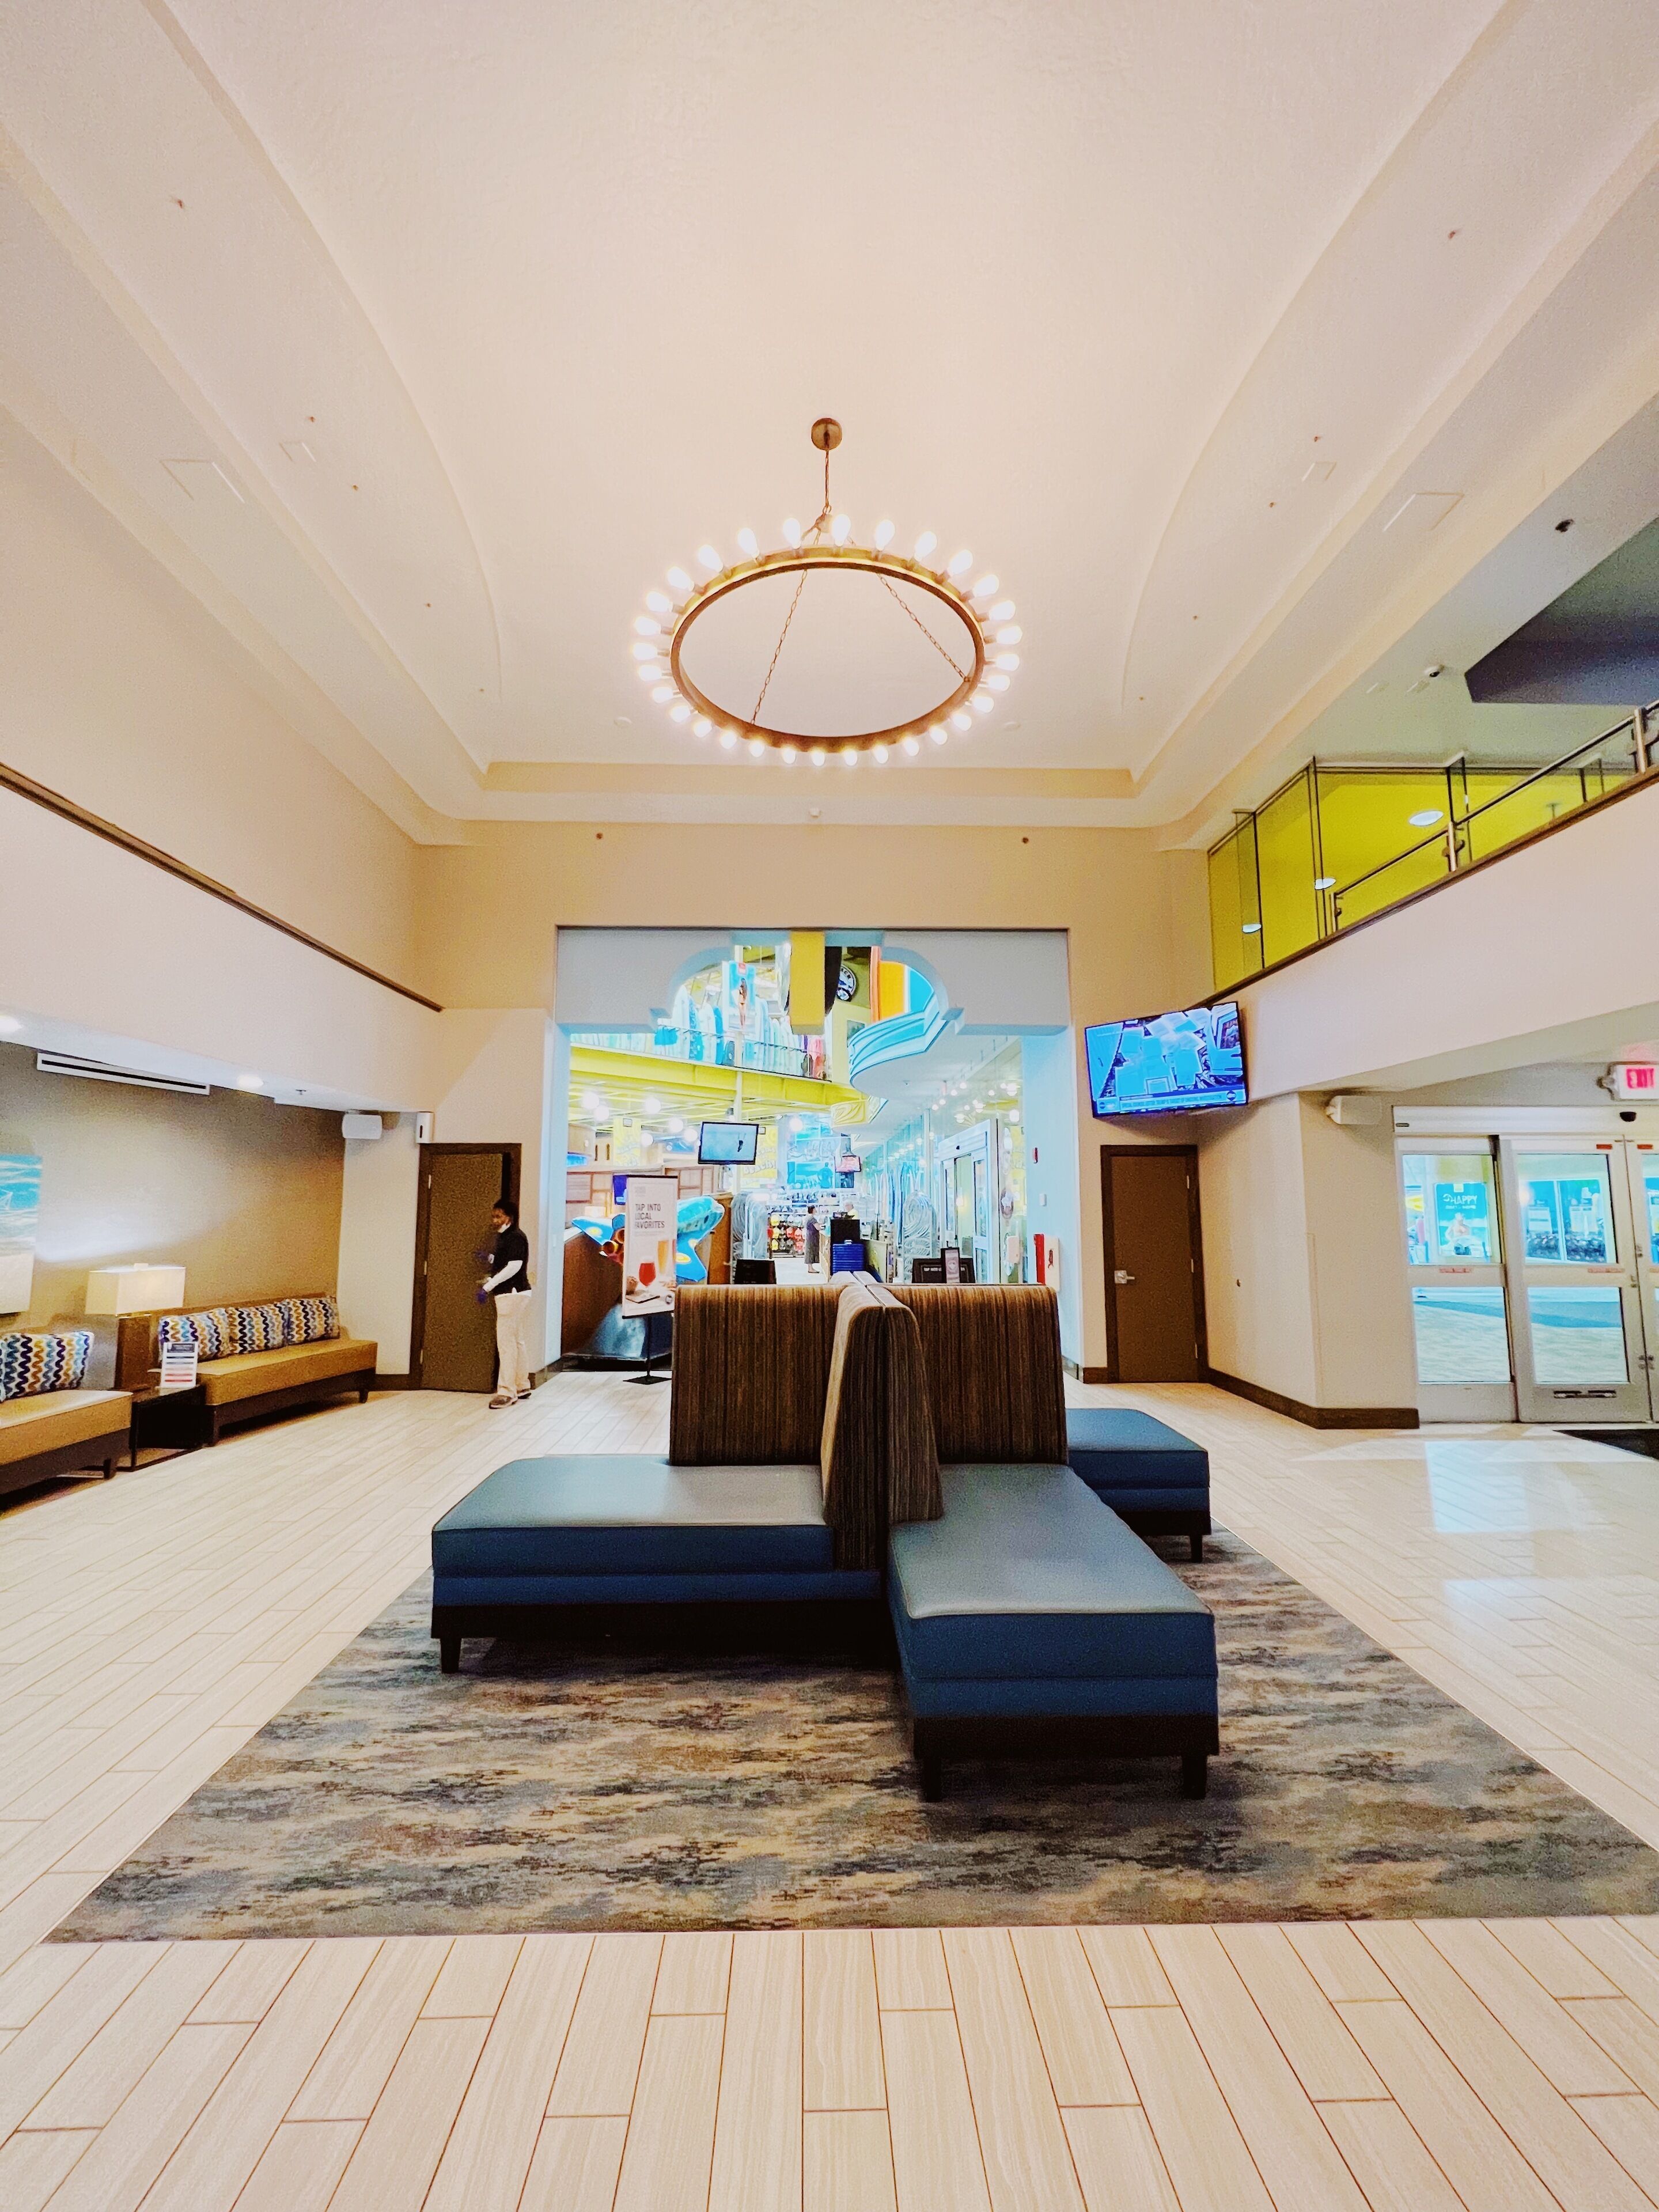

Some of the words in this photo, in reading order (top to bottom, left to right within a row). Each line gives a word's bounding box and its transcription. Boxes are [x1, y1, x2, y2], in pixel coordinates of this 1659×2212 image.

[1626, 1068, 1654, 1089] EXIT
[635, 1203, 645, 1211] TAP
[647, 1203, 661, 1211] INTO
[635, 1221, 665, 1229] FAVORITES
